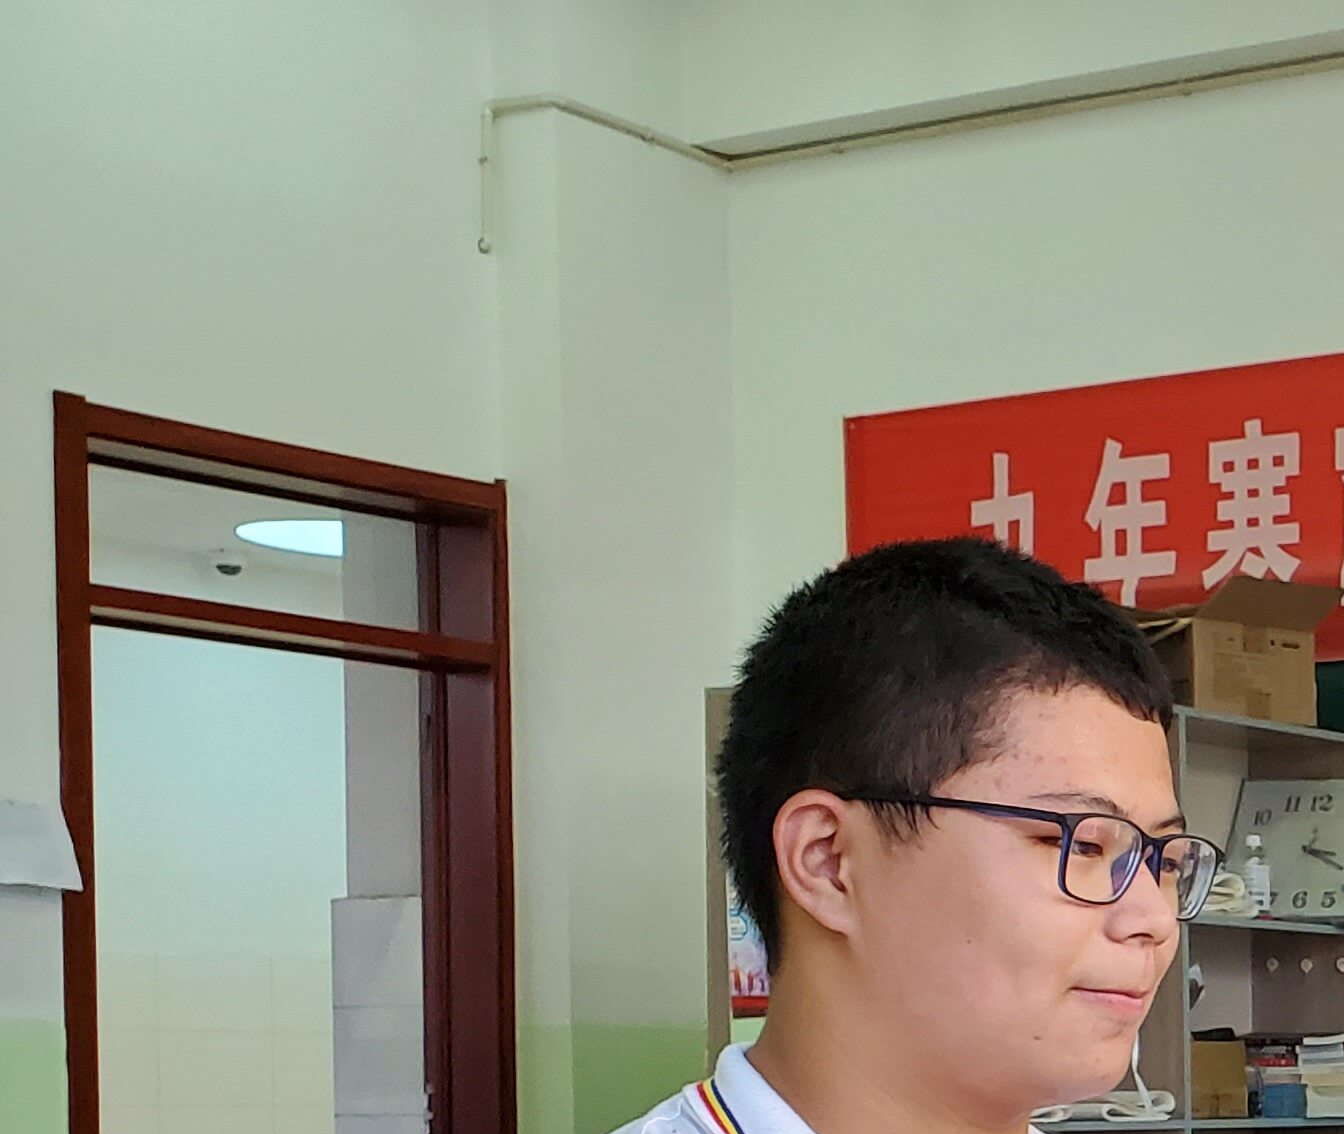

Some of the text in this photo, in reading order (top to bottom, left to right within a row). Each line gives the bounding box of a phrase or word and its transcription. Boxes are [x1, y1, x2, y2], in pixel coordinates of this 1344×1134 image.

[1285, 795, 1300, 812] 11
[1310, 794, 1333, 812] 12
[1254, 809, 1272, 825] 10
[1292, 891, 1308, 908] 6
[1321, 891, 1337, 908] 5
